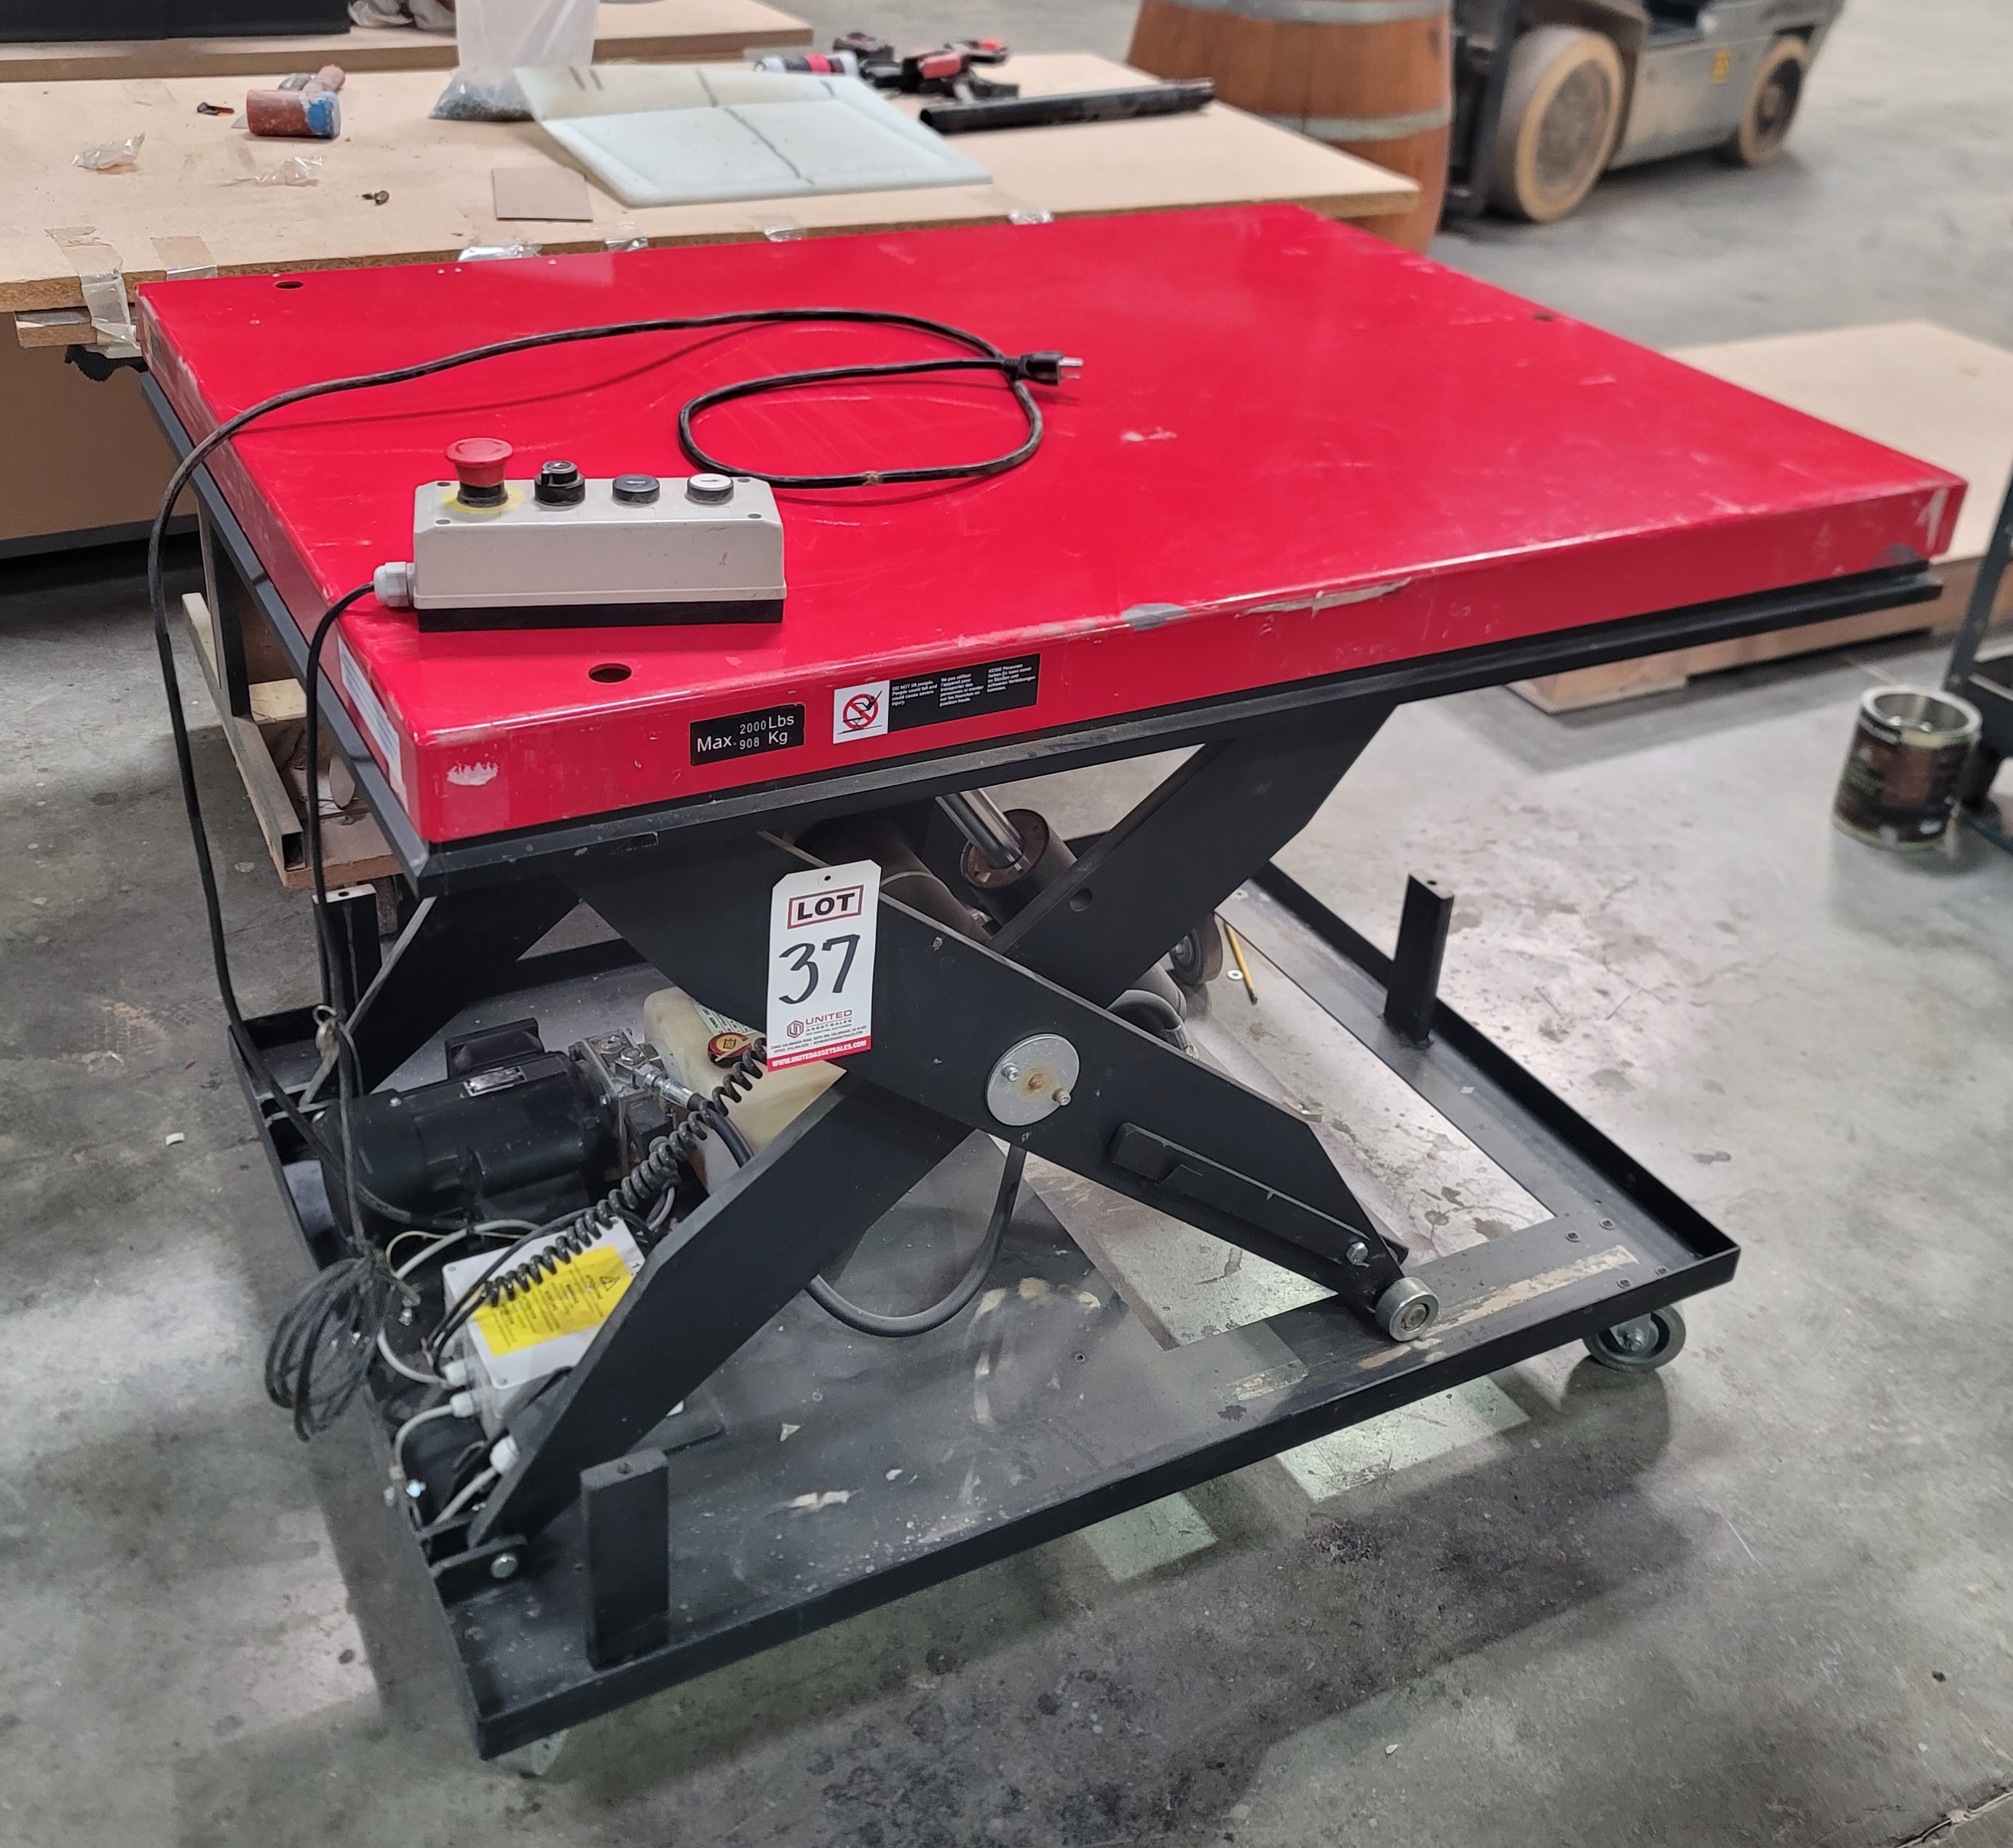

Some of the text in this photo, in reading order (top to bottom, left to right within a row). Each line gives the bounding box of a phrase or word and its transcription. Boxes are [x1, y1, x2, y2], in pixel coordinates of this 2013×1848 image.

[740, 715, 795, 735] 2000 Lbs
[697, 735, 737, 752] Max.
[740, 730, 788, 750] 908 Kg
[797, 893, 855, 920] LOT
[778, 933, 861, 1005] 37
[805, 1009, 853, 1024] UNITED
[806, 1024, 828, 1032] ASSET
